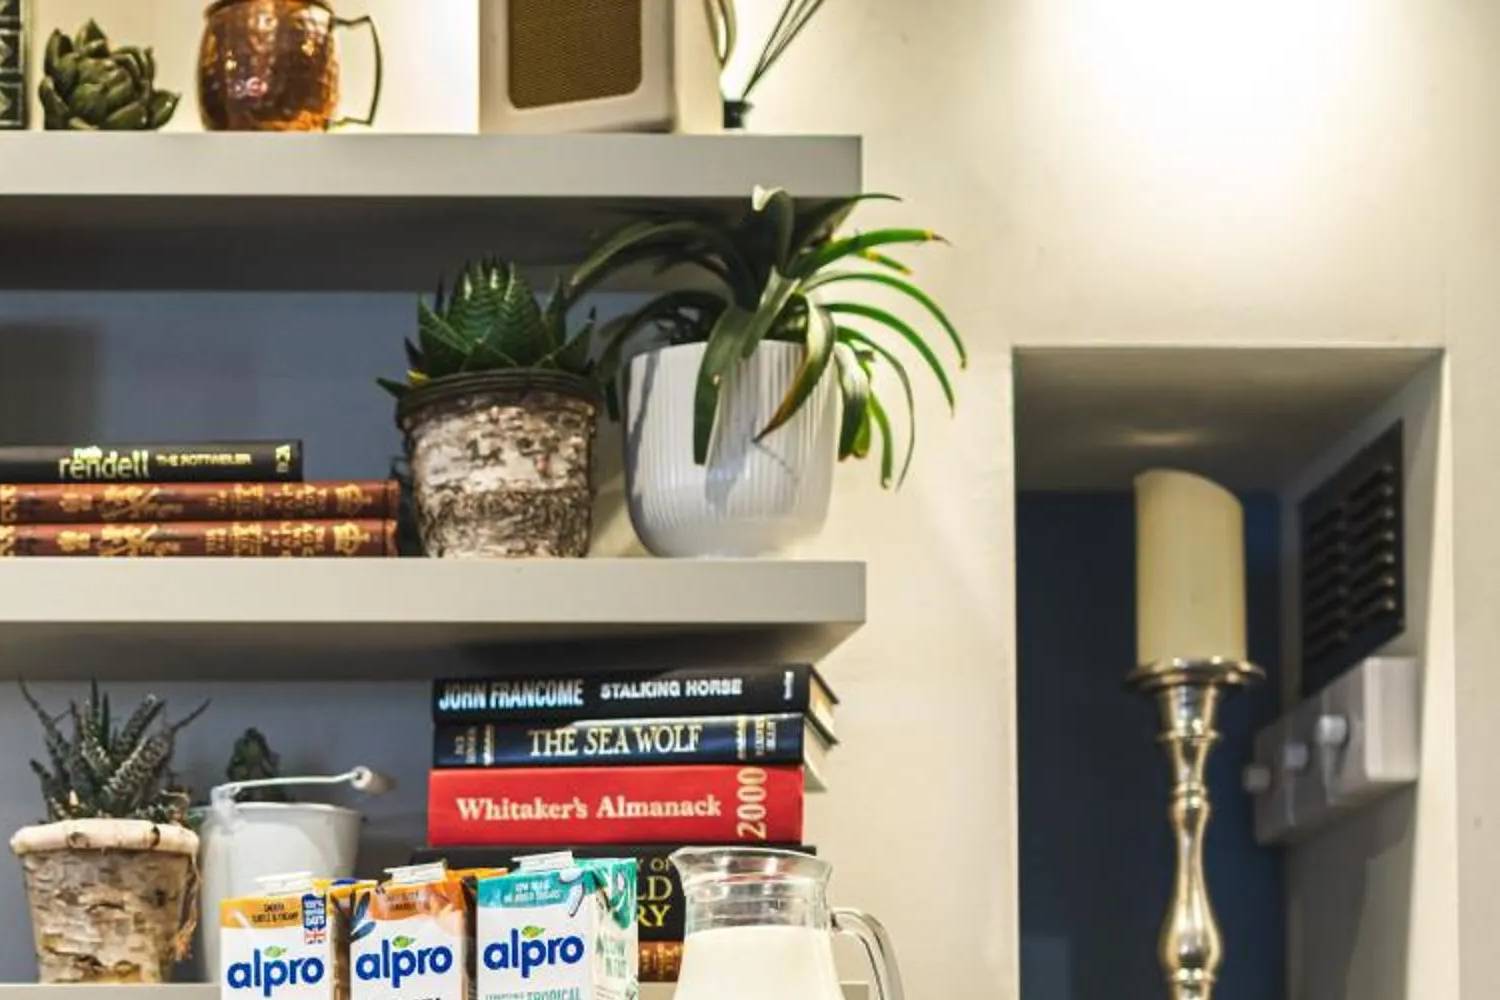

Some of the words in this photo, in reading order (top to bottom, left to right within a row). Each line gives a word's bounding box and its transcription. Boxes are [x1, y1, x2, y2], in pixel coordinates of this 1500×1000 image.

[59, 450, 149, 478] rendell
[438, 682, 487, 711] JOHN
[489, 679, 585, 709] FRANCOME
[600, 680, 681, 699] STALKING
[685, 678, 743, 697] HORSE
[528, 727, 578, 757] THE
[583, 726, 631, 755] SEA
[632, 723, 703, 753] WOLF
[455, 795, 589, 821] Whitaker's
[596, 794, 722, 818] Almanack
[736, 766, 768, 840] 2000
[355, 938, 453, 989] alpro
[483, 927, 585, 979] alpro
[227, 947, 325, 998] alpro
